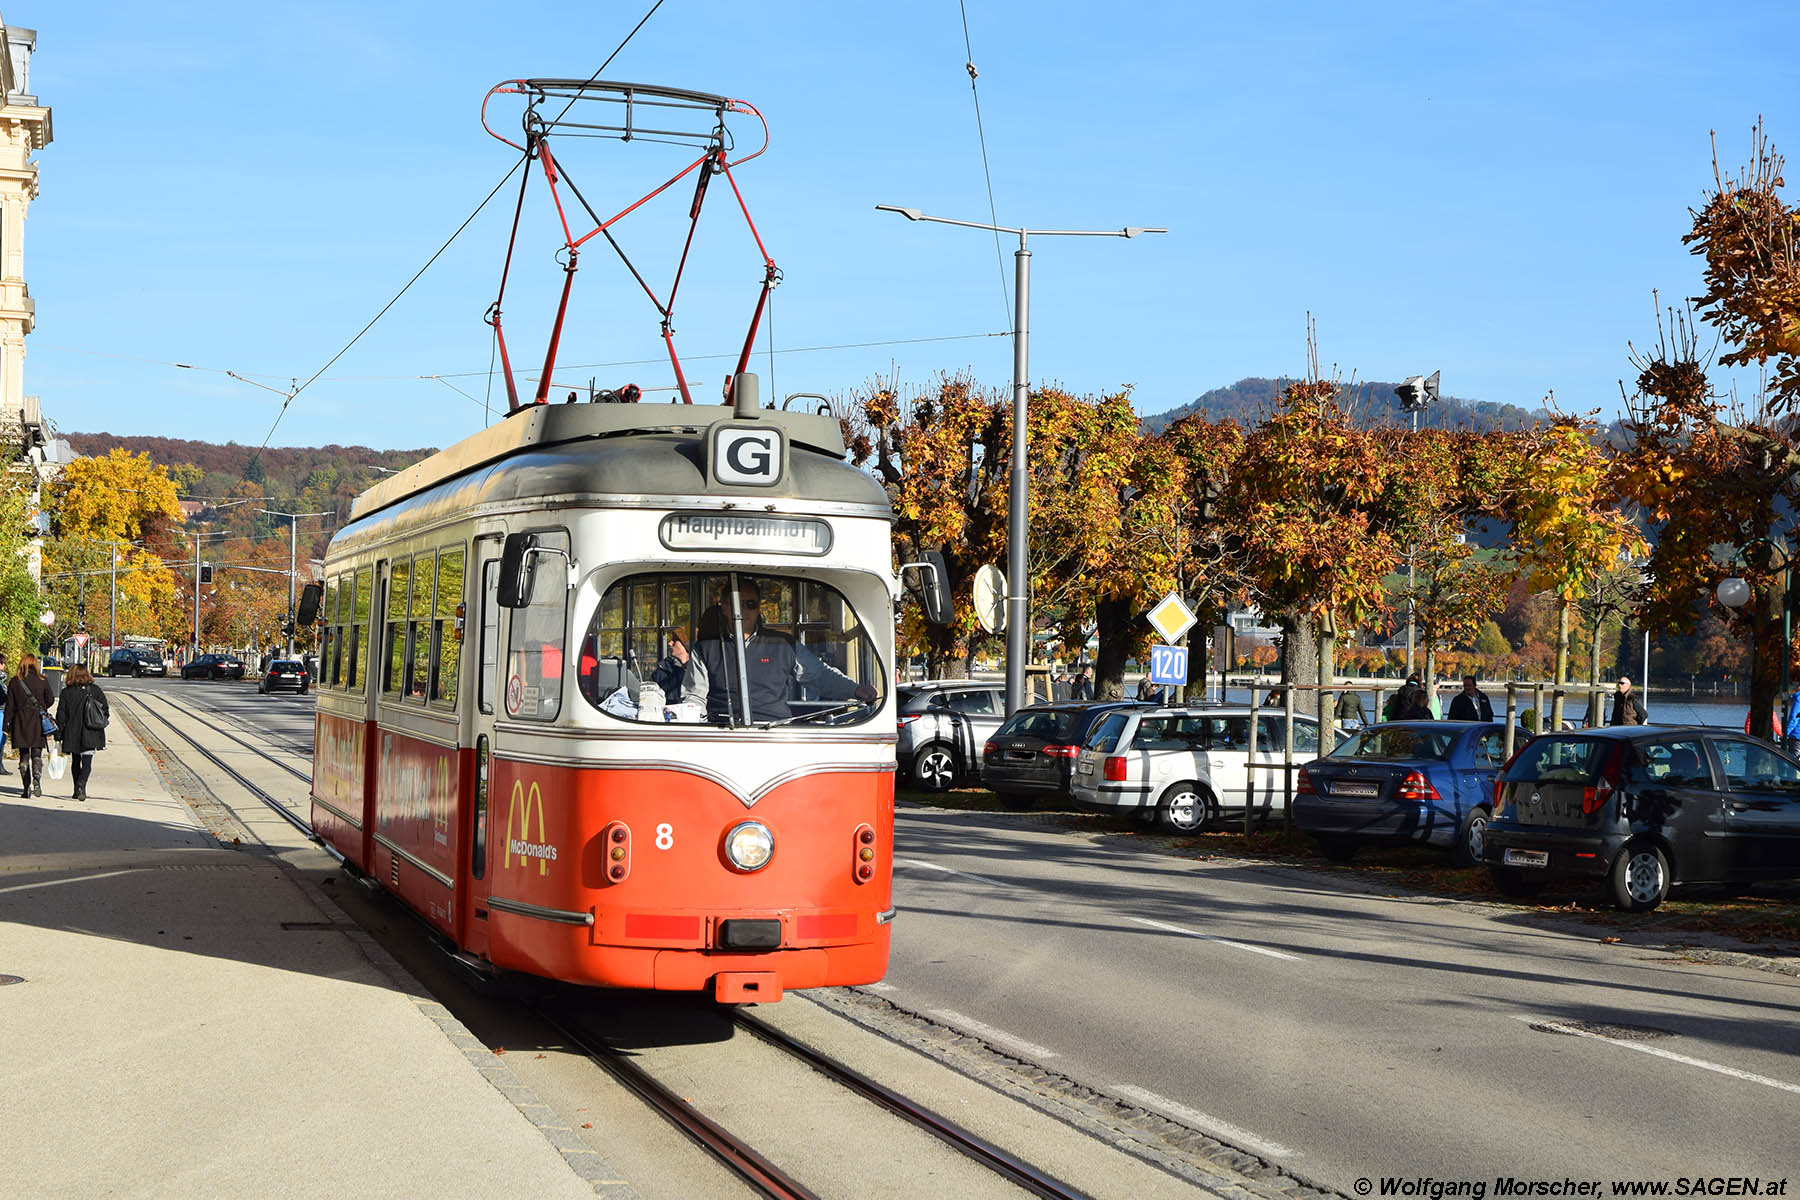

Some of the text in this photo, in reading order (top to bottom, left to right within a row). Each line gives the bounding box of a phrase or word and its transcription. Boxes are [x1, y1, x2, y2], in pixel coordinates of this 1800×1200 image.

[727, 436, 771, 476] G
[1153, 649, 1185, 680] 120
[510, 839, 557, 861] McDonald's
[655, 823, 674, 850] 8
